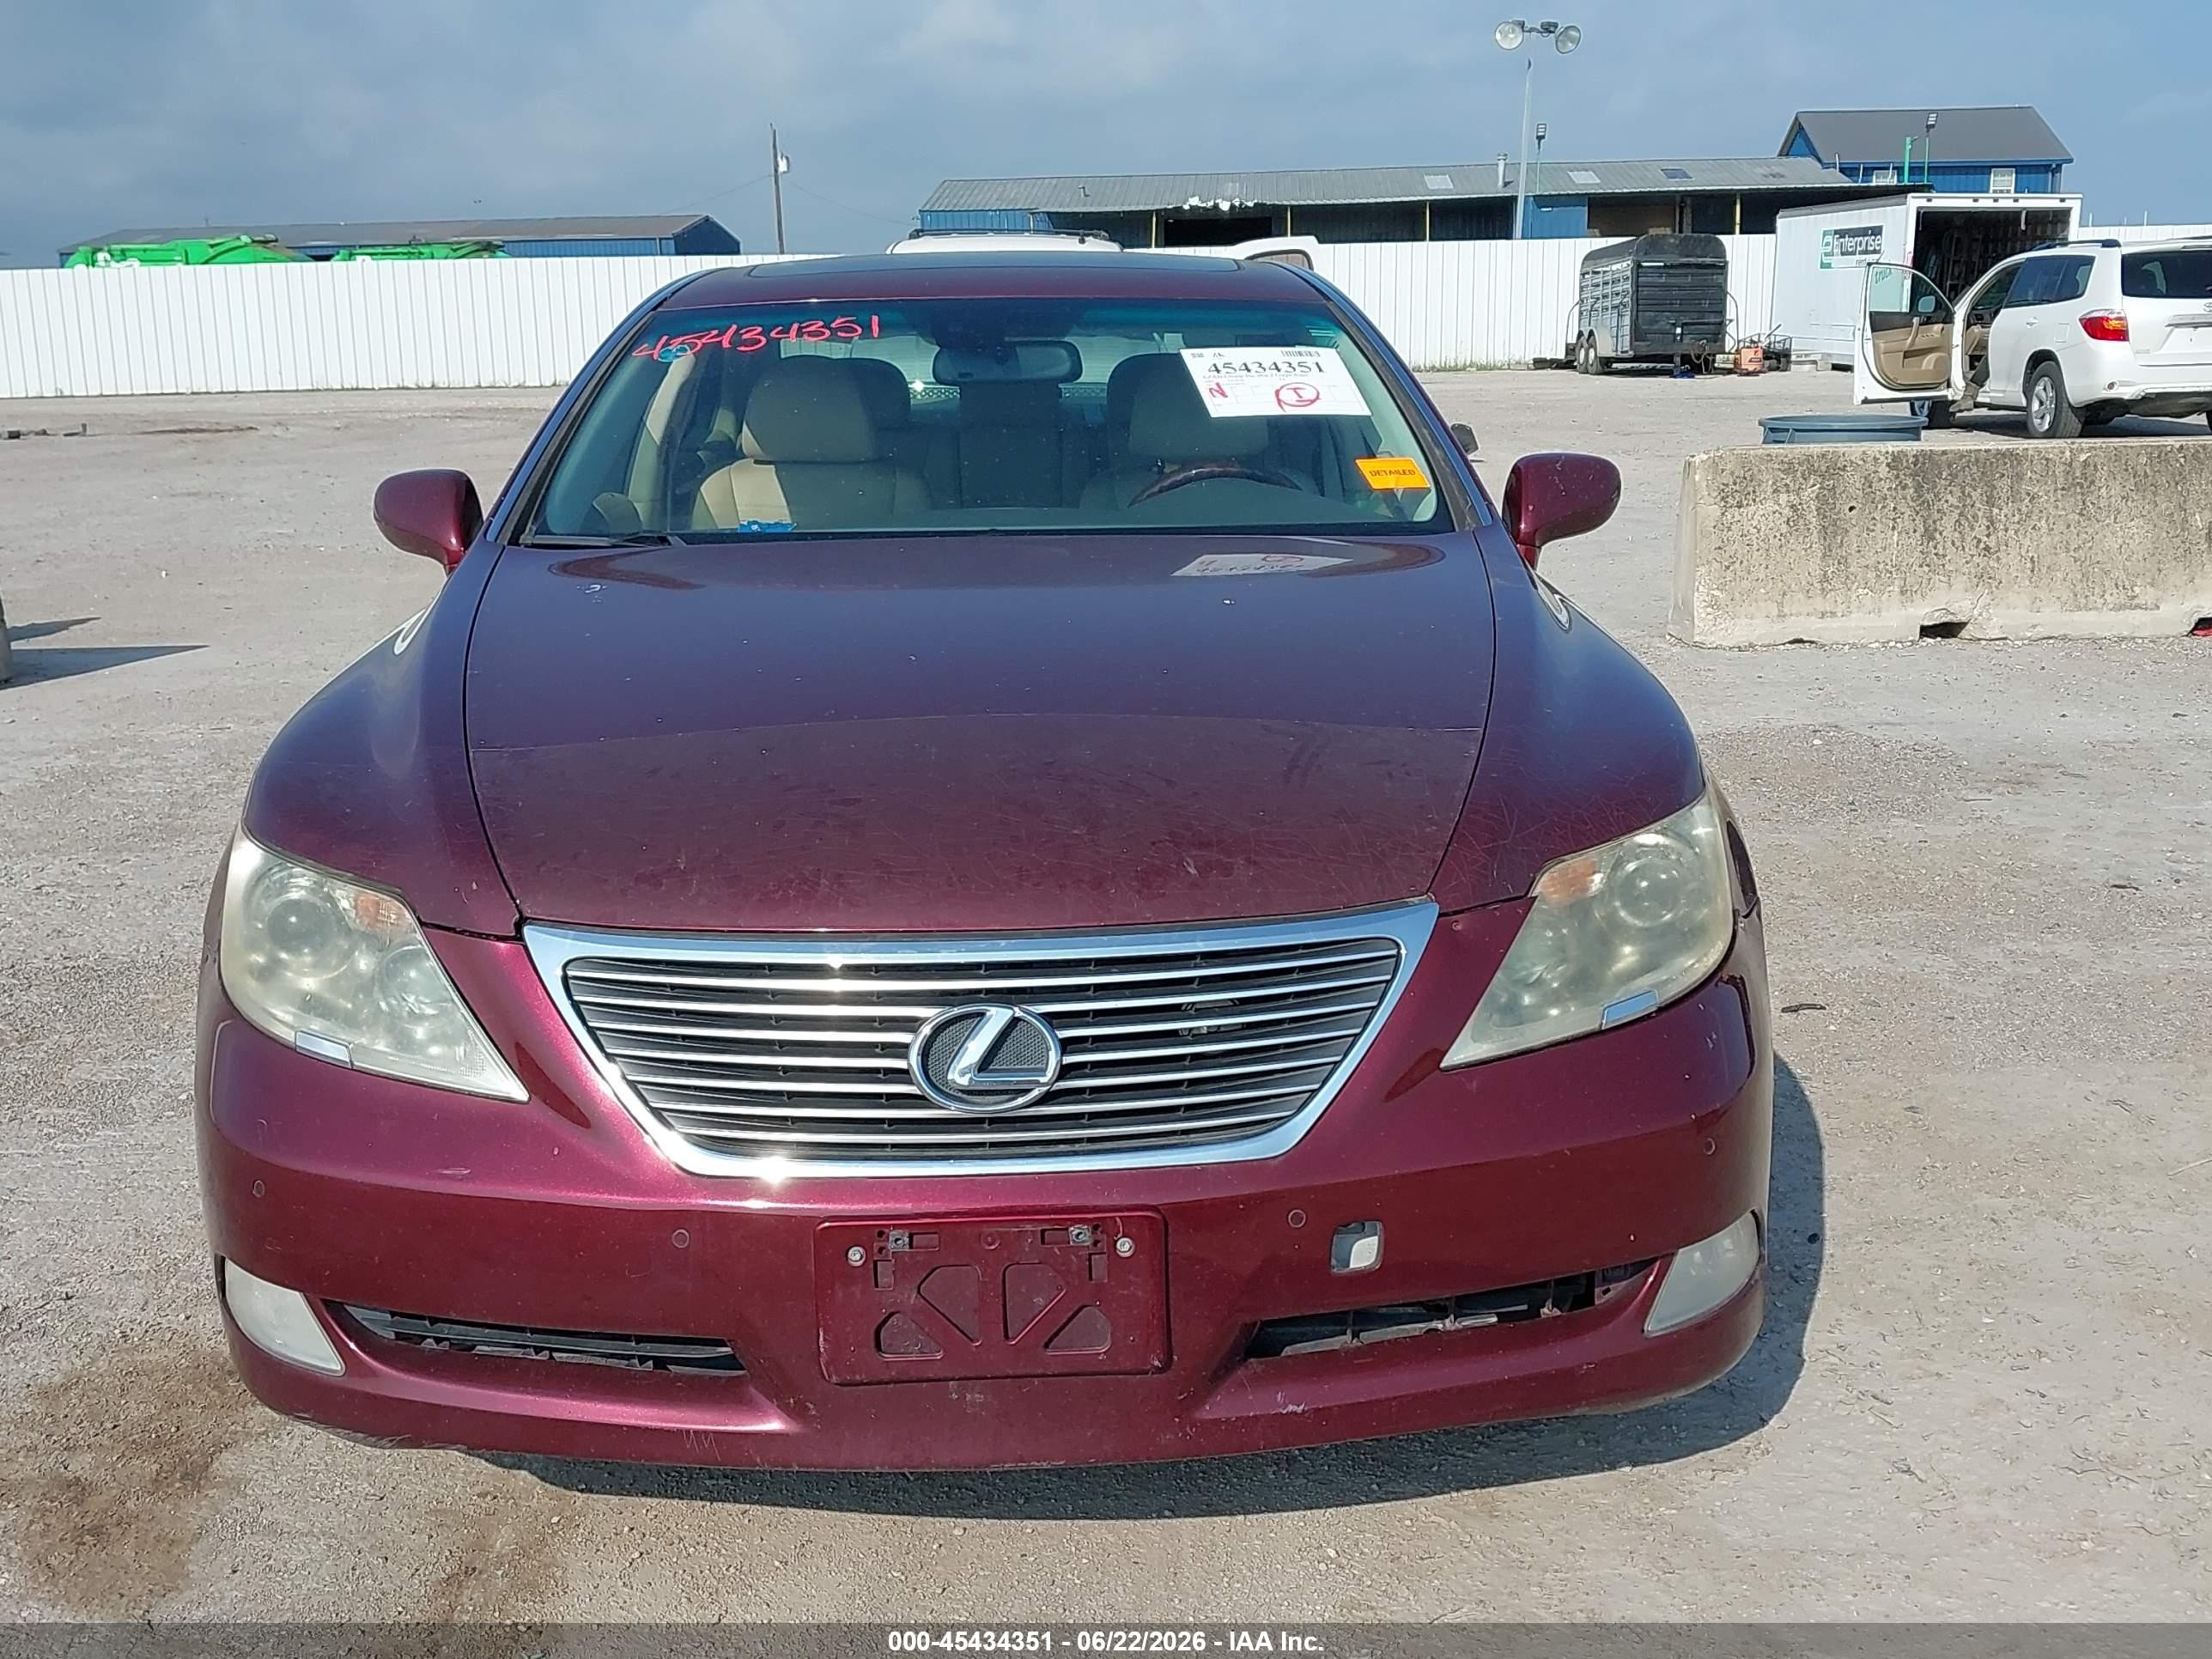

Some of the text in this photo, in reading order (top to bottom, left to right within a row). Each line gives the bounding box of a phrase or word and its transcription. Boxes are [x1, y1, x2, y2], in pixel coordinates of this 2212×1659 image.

[1833, 229, 1882, 257] Enterprise
[632, 314, 879, 360] 45434351
[1207, 361, 1325, 374] 45434351
